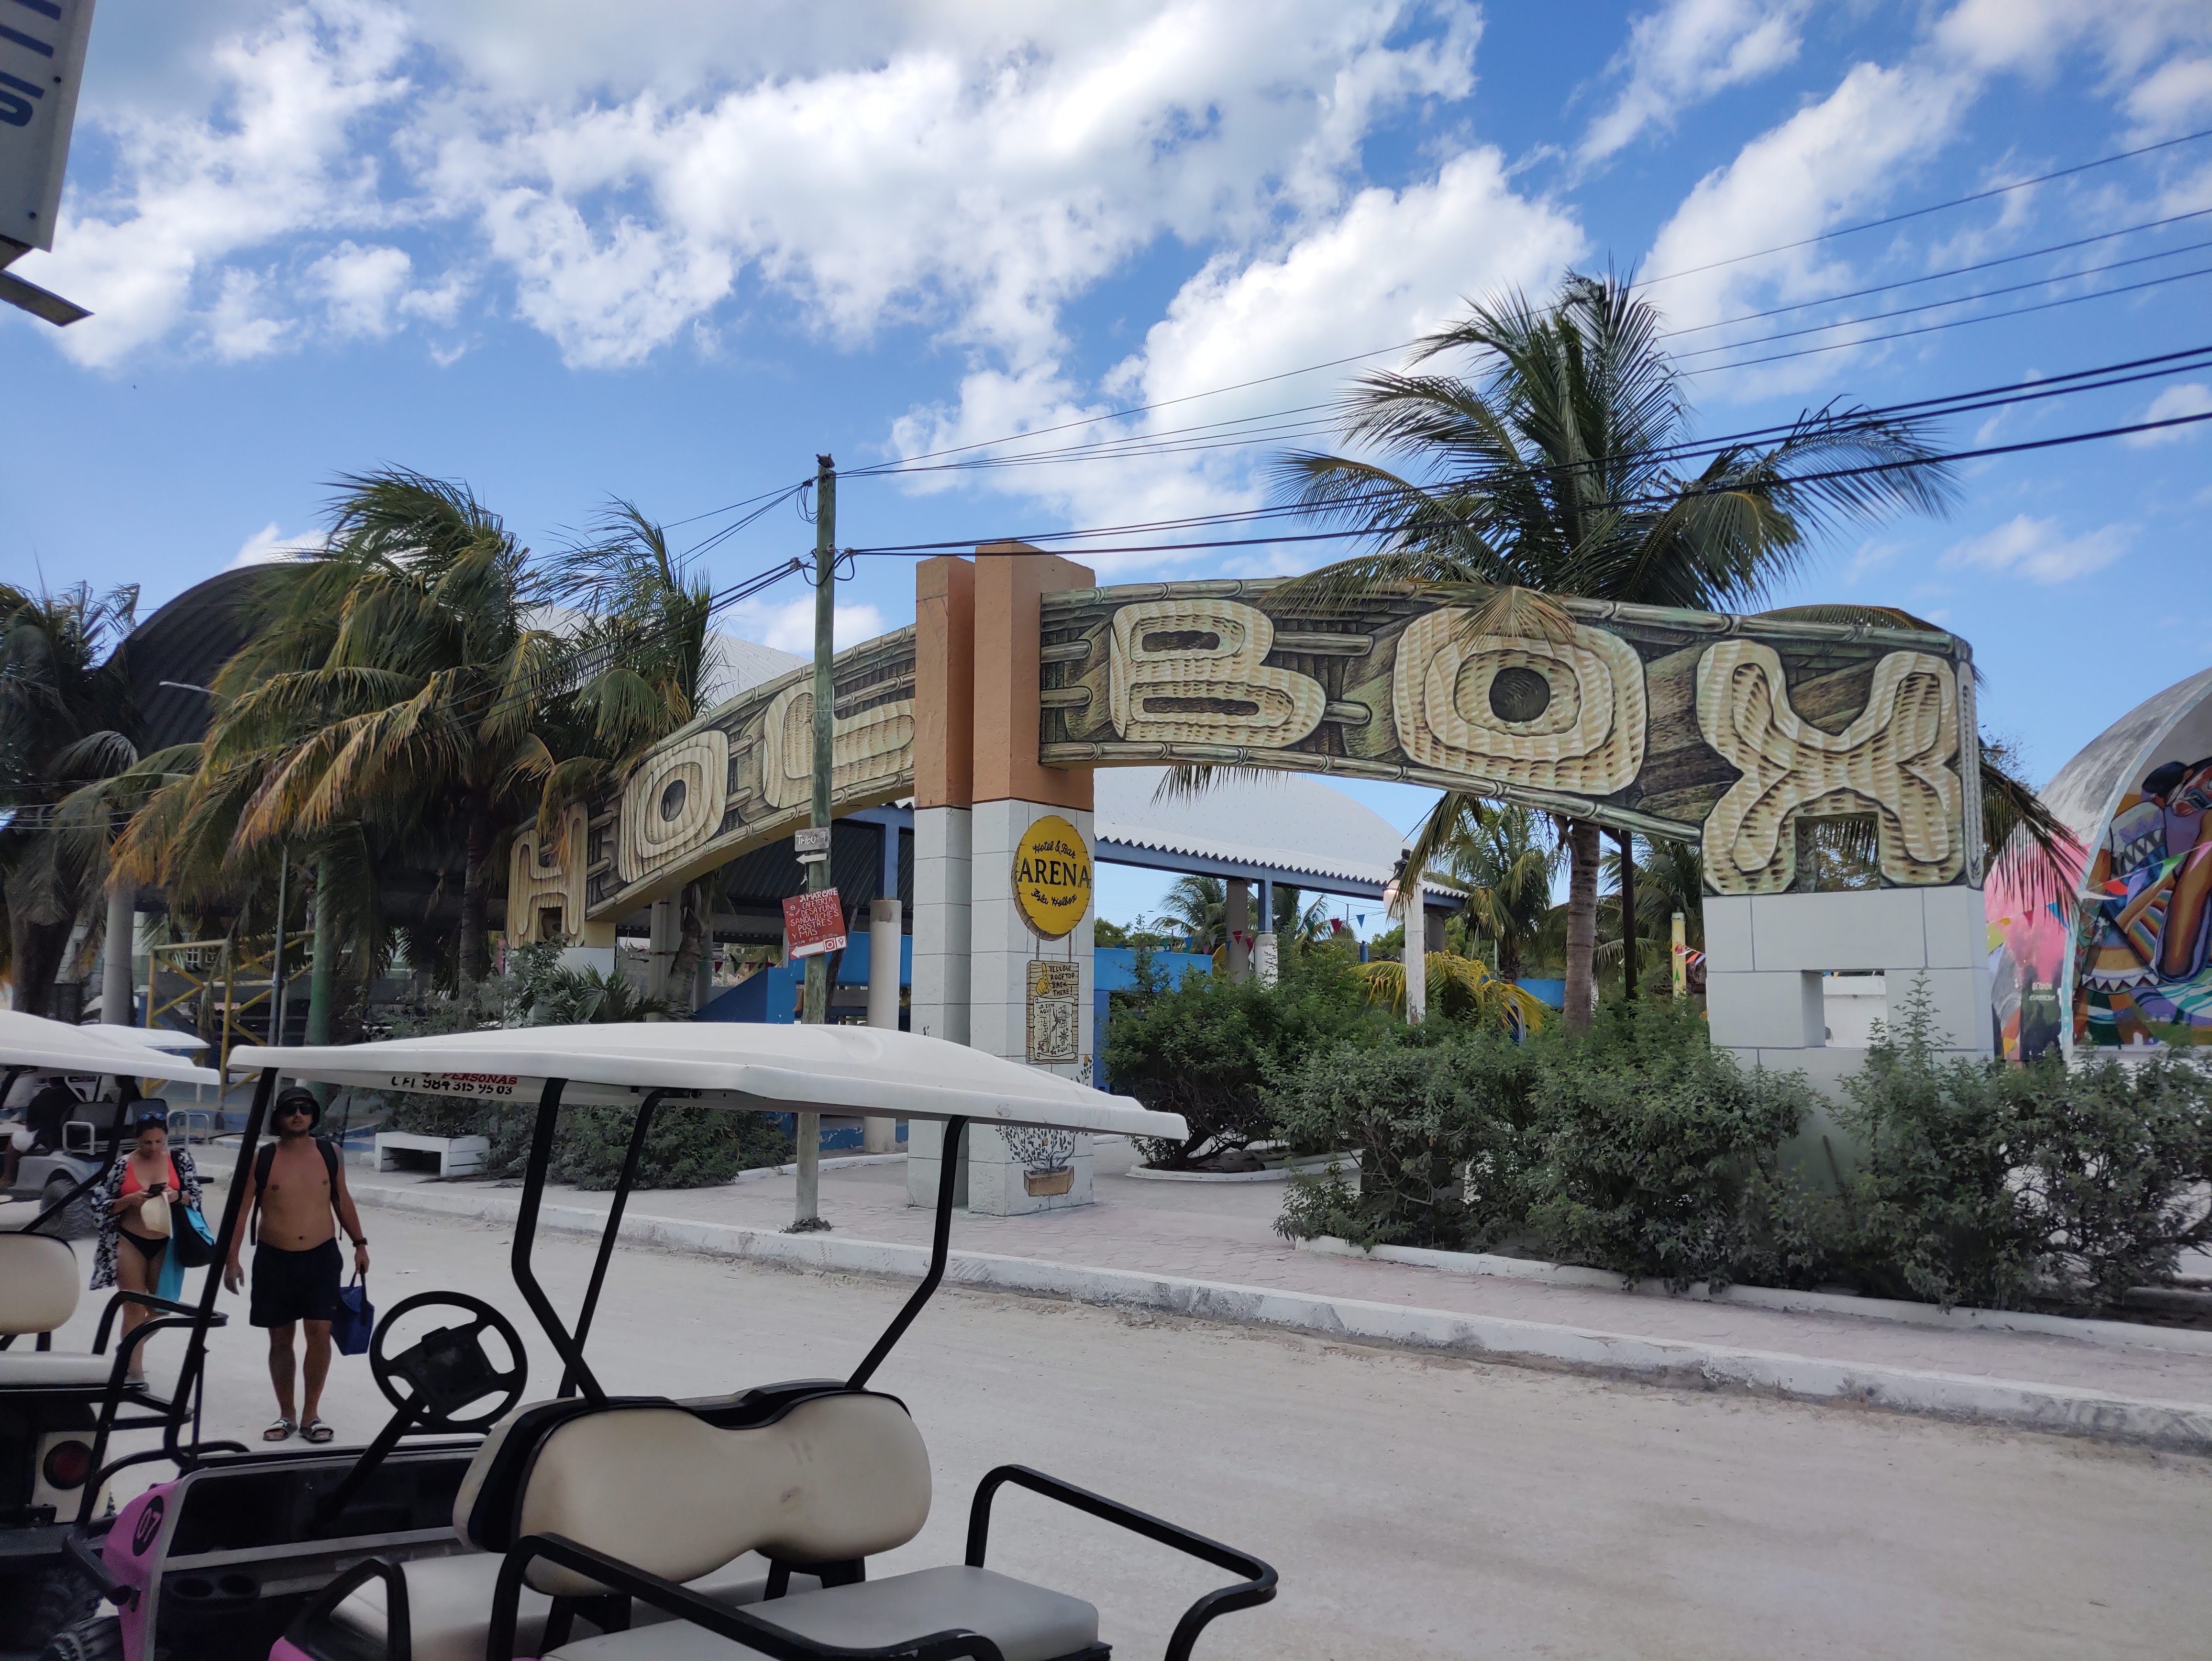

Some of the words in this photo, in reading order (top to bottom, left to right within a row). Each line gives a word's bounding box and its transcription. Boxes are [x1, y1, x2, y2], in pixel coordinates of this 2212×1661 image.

[1032, 841, 1053, 853] Hotel
[1055, 840, 1062, 855] &
[1061, 843, 1076, 859] Bar
[1018, 857, 1092, 889] ARENA
[1051, 894, 1077, 907] Holbox
[801, 903, 836, 917] DESAYUNO
[790, 909, 839, 927] SANDWICHES
[798, 918, 833, 931] POSTRES
[1049, 964, 1071, 973] YELLOW
[1053, 986, 1073, 997] THERE!
[137, 1507, 161, 1543] 07
